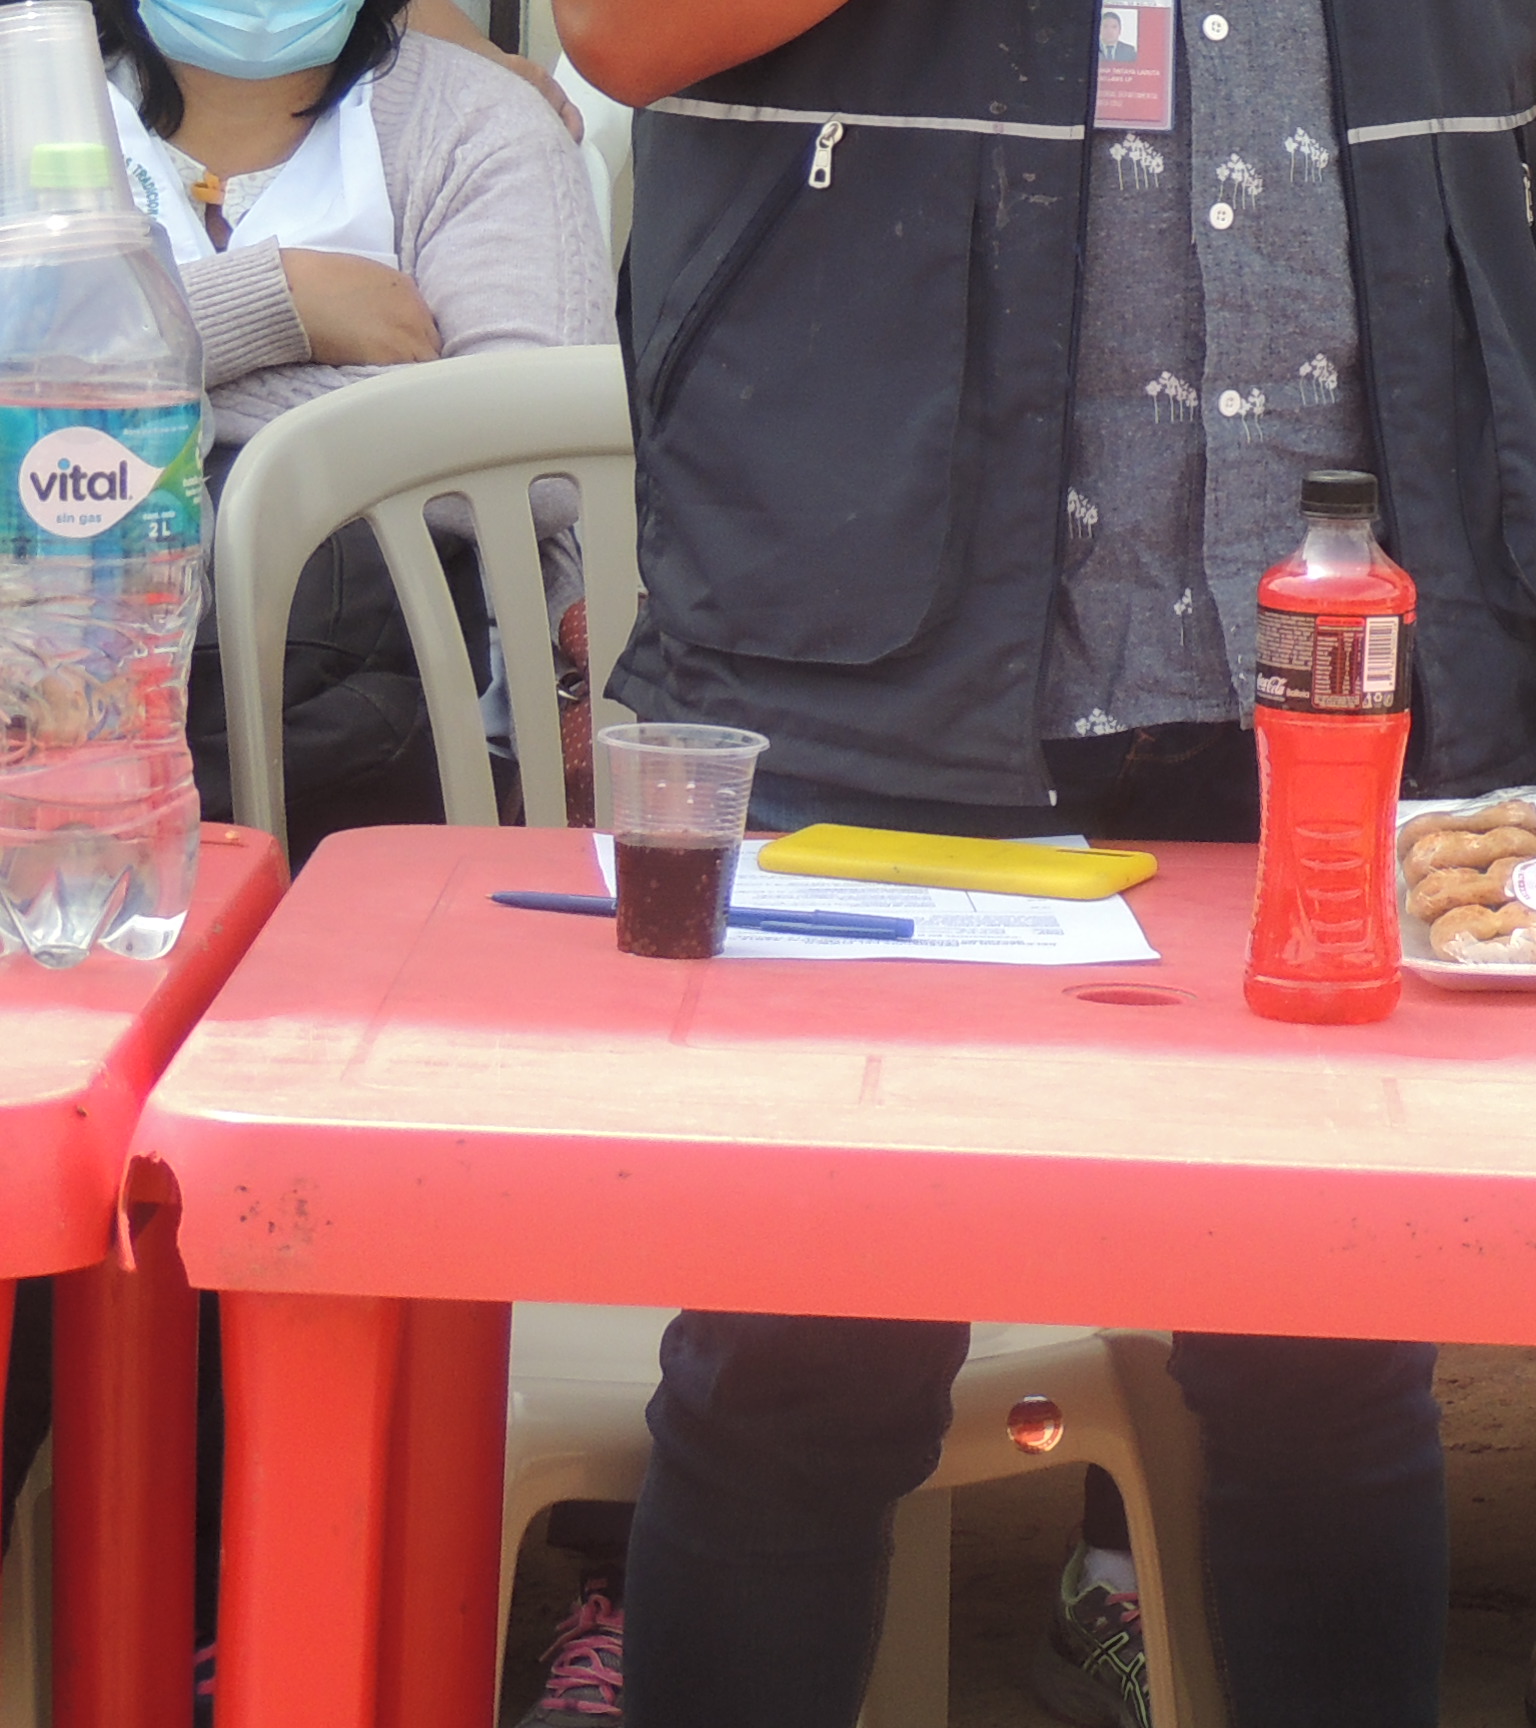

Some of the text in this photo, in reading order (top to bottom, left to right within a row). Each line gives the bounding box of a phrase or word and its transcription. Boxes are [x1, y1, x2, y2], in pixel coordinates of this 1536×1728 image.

[30, 458, 128, 502] vital
[56, 513, 102, 525] sin gas
